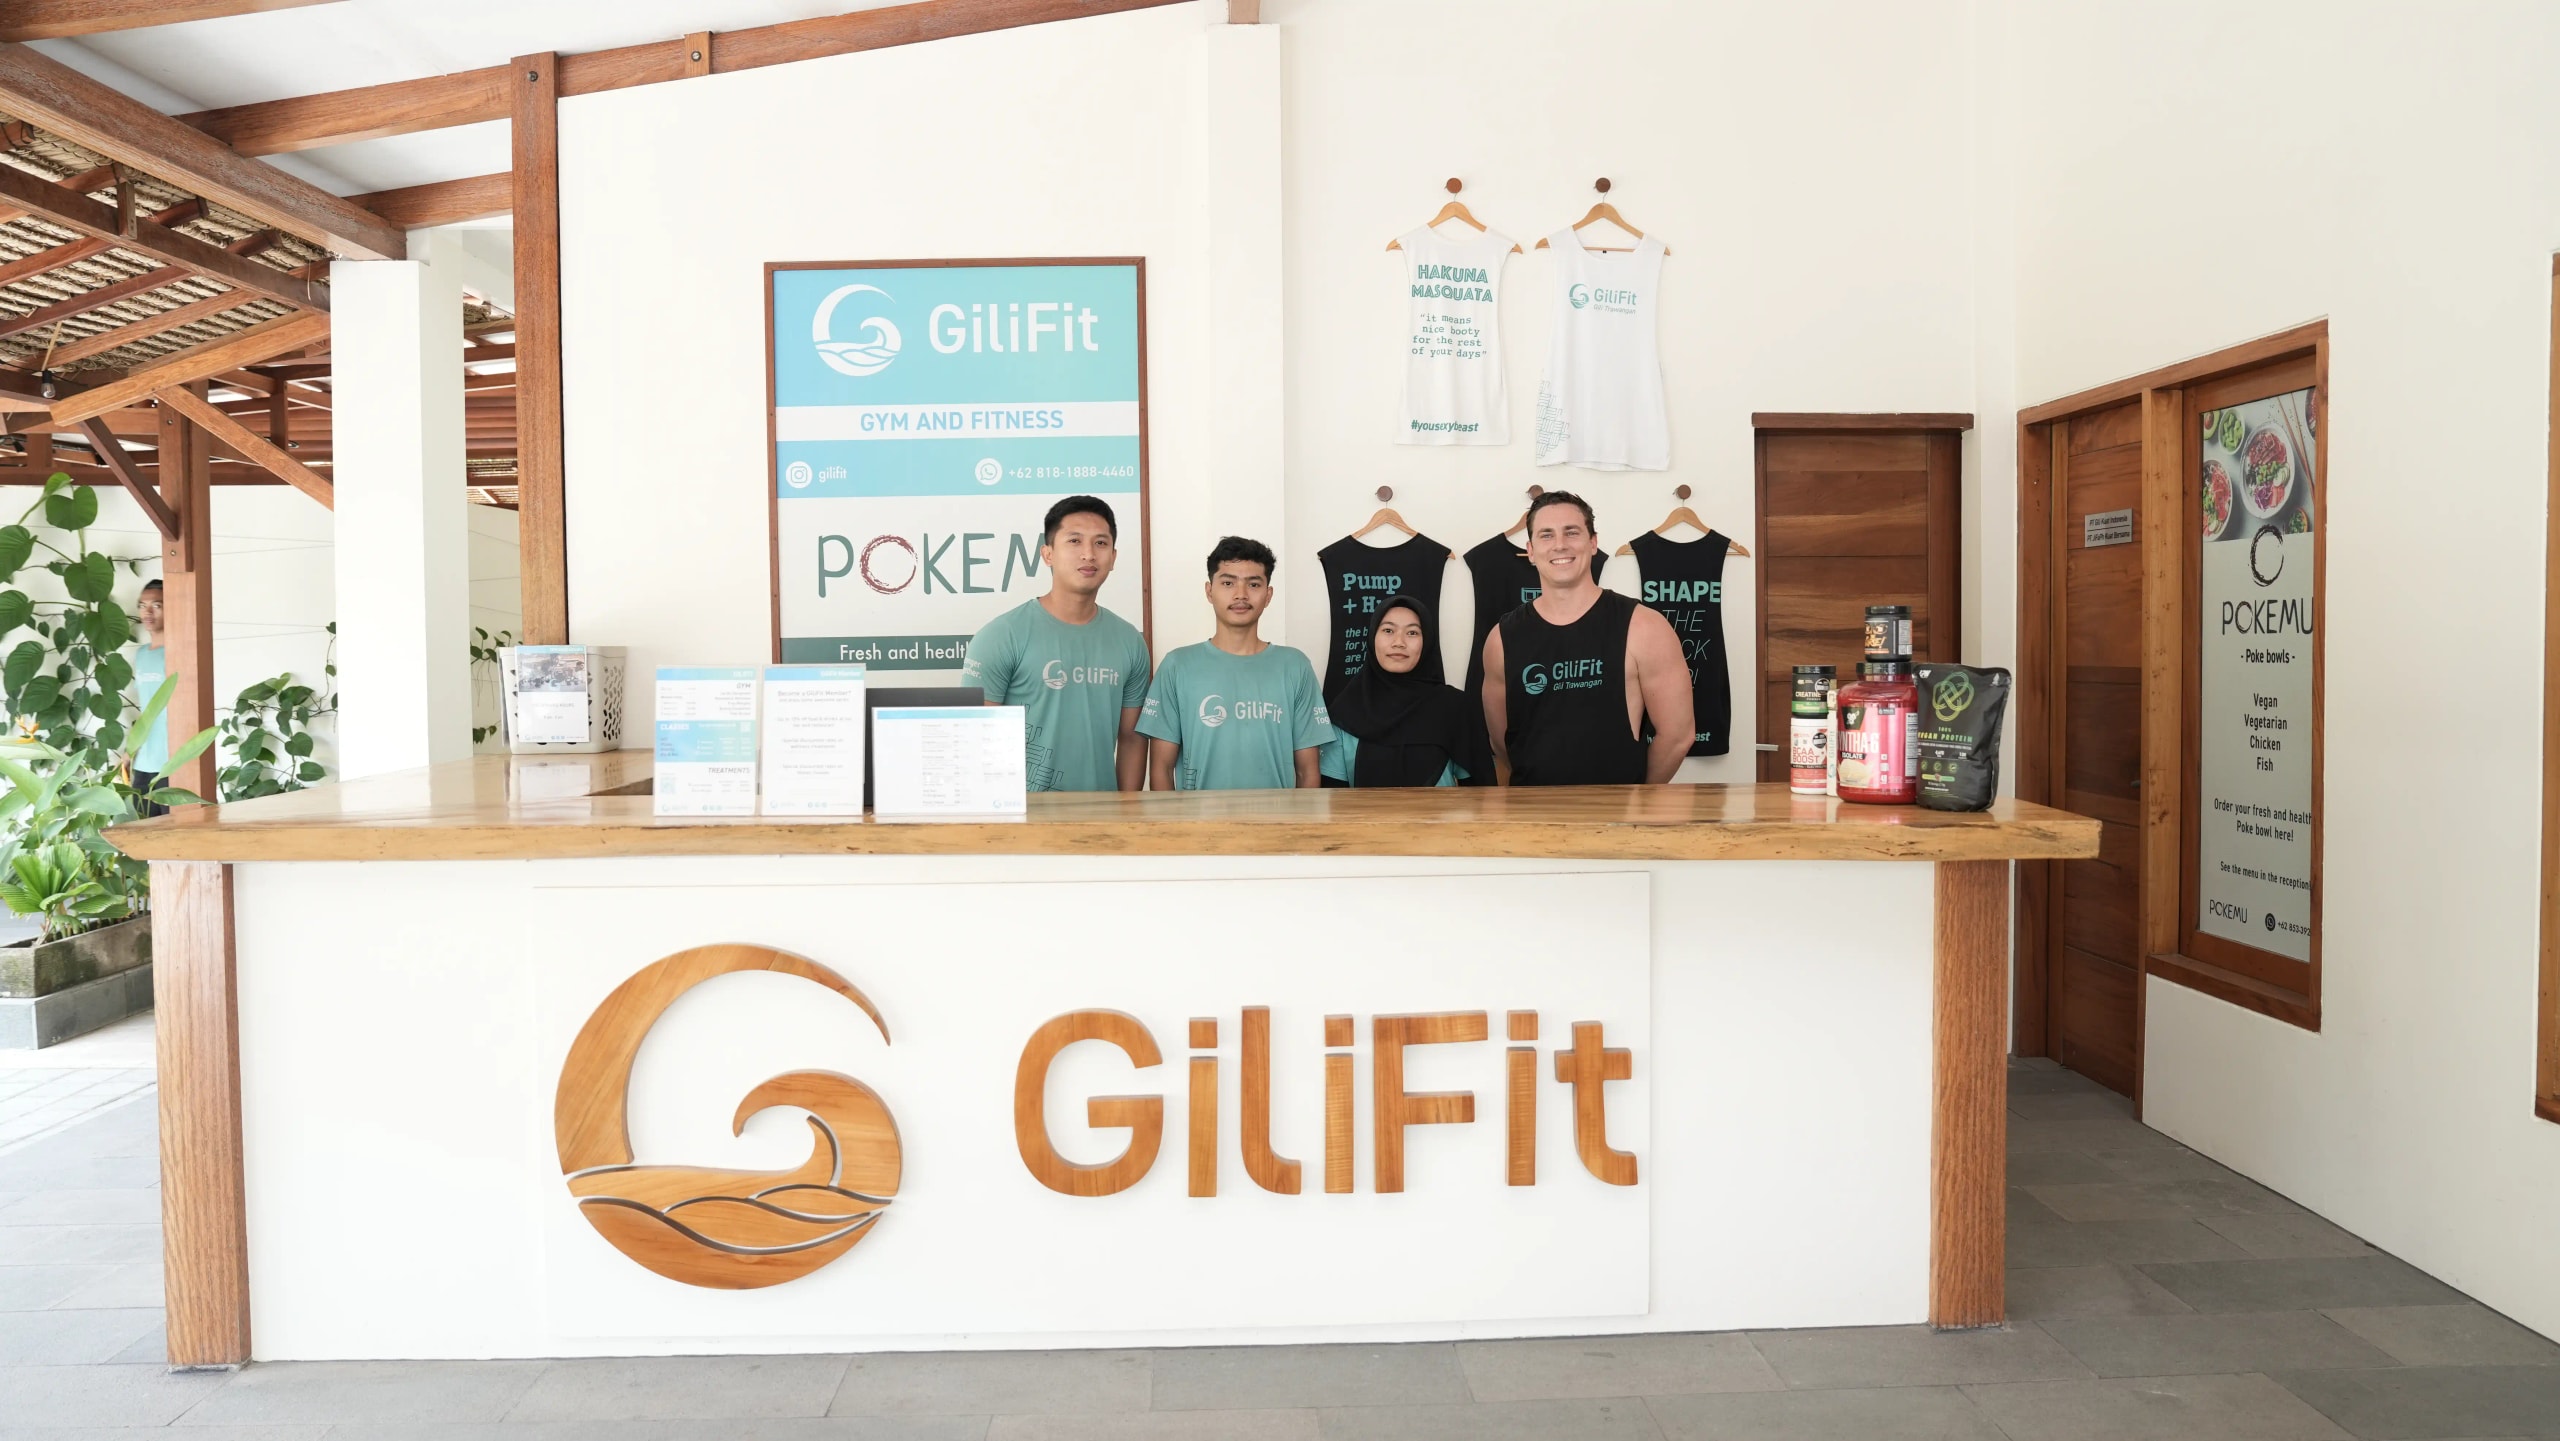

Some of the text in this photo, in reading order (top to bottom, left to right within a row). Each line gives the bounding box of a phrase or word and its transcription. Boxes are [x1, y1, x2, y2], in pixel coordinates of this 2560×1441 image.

[1418, 264, 1488, 283] HAKUNA
[1411, 284, 1493, 302] MASQUATA
[1594, 288, 1637, 305] GiliFit
[929, 302, 1099, 354] GiliFit
[1441, 315, 1472, 324] means
[1412, 335, 1431, 344] for
[1437, 335, 1453, 344] the
[1422, 325, 1480, 337] nice booty
[1411, 346, 1425, 354] of
[1430, 348, 1453, 358] your
[860, 410, 1064, 432] GYM AND FITNESS
[1410, 419, 1479, 432] #yousexybeast
[818, 465, 848, 482] gilifit
[1008, 464, 1134, 479] +62 818-1888-4460
[818, 533, 1044, 598] POKEM
[1343, 573, 1402, 594] Pump
[1643, 580, 1721, 603] SHAPE
[1343, 598, 1357, 614] +
[1662, 609, 1706, 632] THE
[2221, 597, 2314, 636] POKEMU
[1345, 628, 1360, 638] the
[840, 640, 970, 660] Fresh and healt
[1345, 641, 1359, 651] for
[1681, 638, 1711, 661] CK
[1345, 654, 1361, 663] are
[2245, 648, 2264, 663] Poke
[2266, 648, 2290, 663] bowls
[1072, 666, 1120, 686] GliFit
[1552, 658, 1604, 680] GiliFit
[2253, 692, 2278, 710] Vegan
[1235, 701, 1283, 724] GiliFit
[1314, 716, 1331, 725] Tog
[2244, 713, 2288, 731] Vegetarian
[1941, 733, 1973, 743] PROTEIN
[2249, 735, 2281, 751] Chicken
[1792, 747, 1814, 756] BCAA
[1792, 755, 1820, 764] BOOST
[2256, 757, 2274, 771] Fish
[2214, 798, 2312, 825] Order your fresh and health
[2236, 820, 2294, 842] Poke bowl here!
[2220, 861, 2231, 872] See
[2232, 864, 2241, 875] the
[2242, 867, 2259, 879] menu
[2260, 869, 2266, 880] in
[2267, 871, 2278, 883] the
[2209, 899, 2248, 924] POKEMU
[2277, 921, 2311, 937] +62 853-392
[1013, 1005, 1639, 1198] GiliFit
